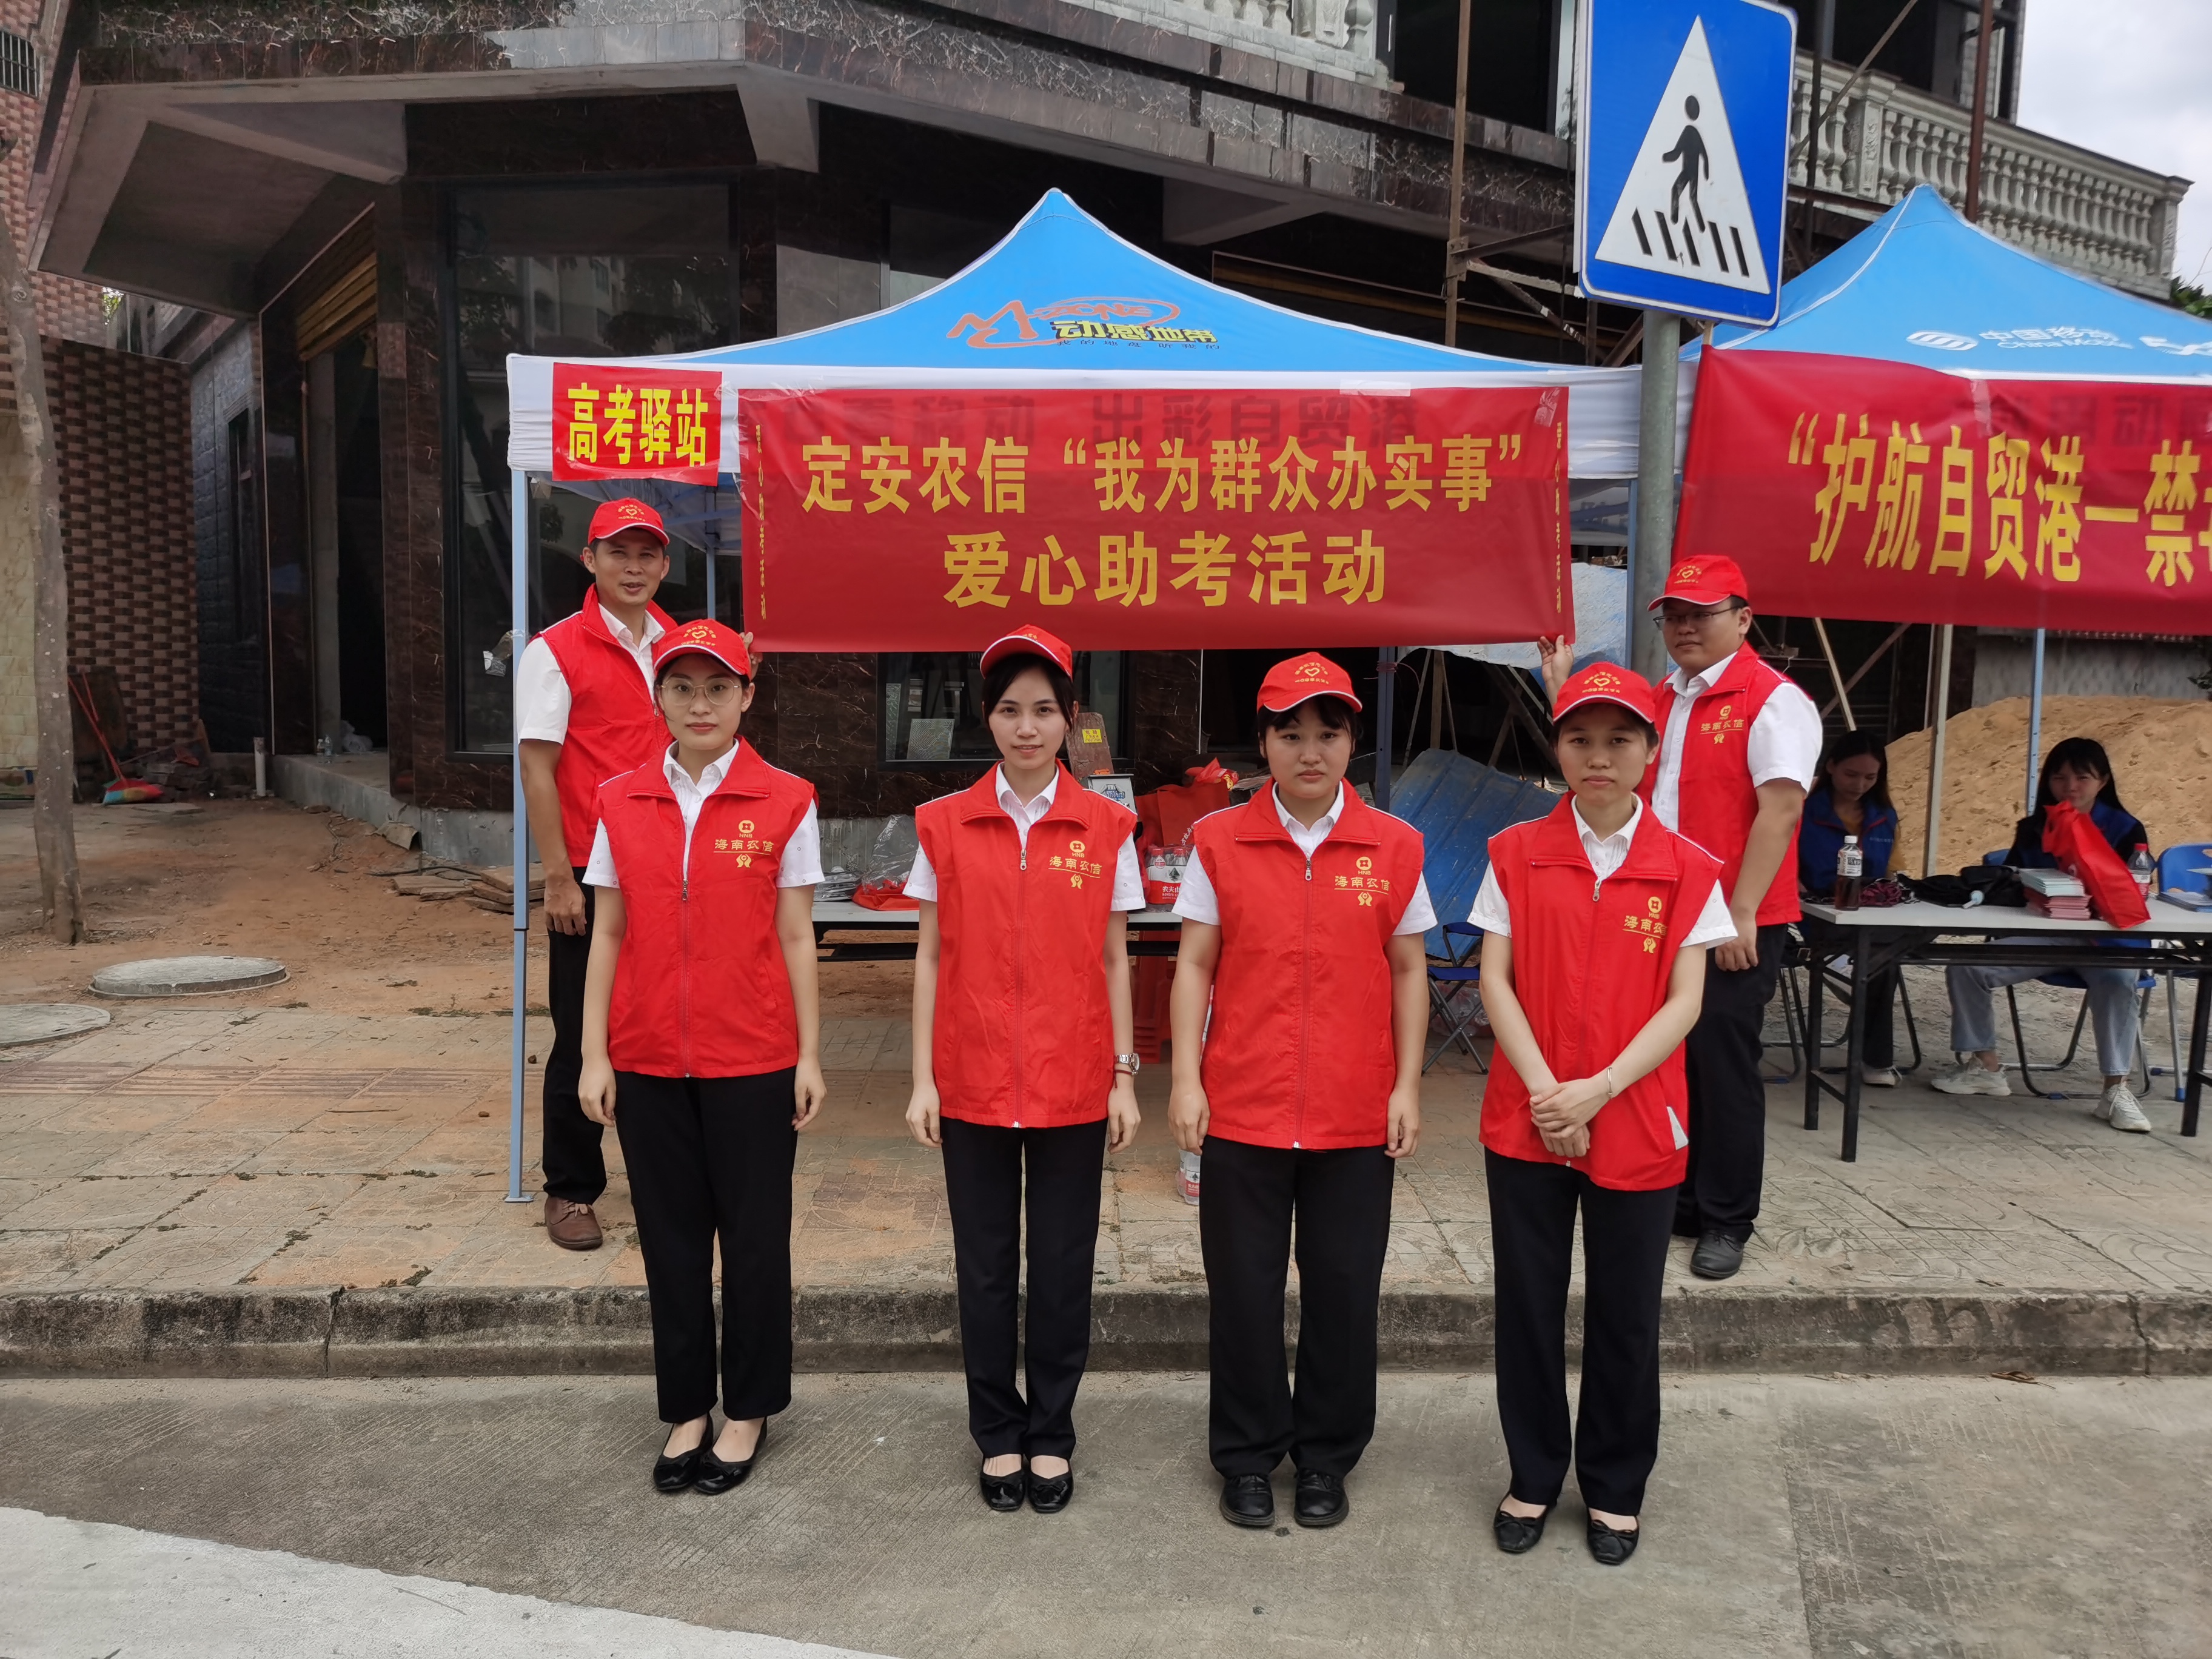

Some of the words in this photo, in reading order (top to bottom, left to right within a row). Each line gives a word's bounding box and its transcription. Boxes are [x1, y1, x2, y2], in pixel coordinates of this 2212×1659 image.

[1050, 320, 1218, 343] 动感地带
[1979, 326, 2120, 341] 中国移动
[1056, 339, 1141, 347] 我的地盘
[1997, 341, 2061, 349] China
[568, 383, 709, 468] 高考驿站
[802, 436, 1030, 515] 定安农信
[1064, 434, 1522, 514] “我为群众办实事”
[1788, 412, 2212, 587] “护航自贸港一禁
[943, 529, 1385, 609] 爱心助考活动
[714, 839, 774, 853] 海南农信
[1049, 855, 1102, 875] 海南农信
[1335, 875, 1390, 891] 海南农信
